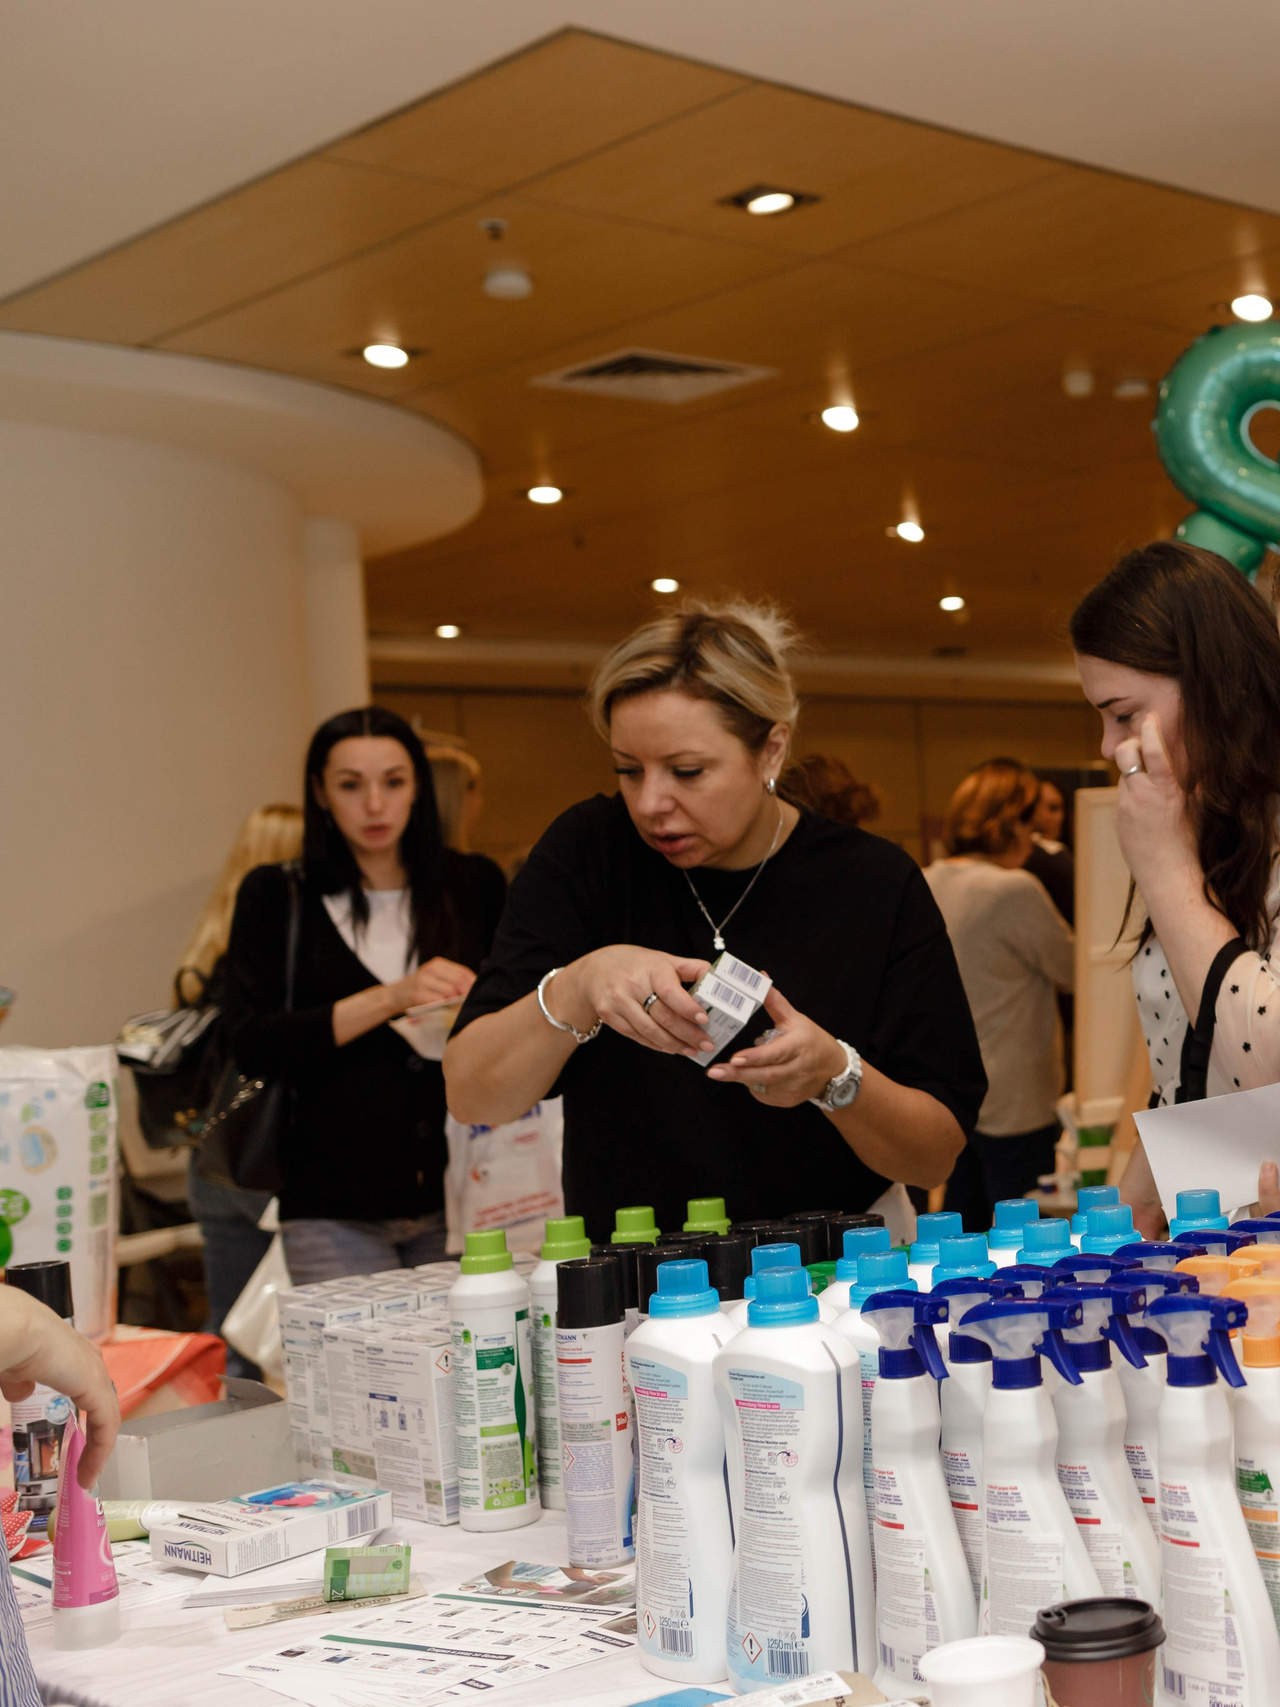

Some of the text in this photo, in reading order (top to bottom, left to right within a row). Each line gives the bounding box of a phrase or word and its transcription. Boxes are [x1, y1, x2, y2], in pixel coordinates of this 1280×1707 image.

[175, 1520, 231, 1536] HEITMANN
[164, 1544, 212, 1566] HEITMANN
[767, 1638, 784, 1650] 1250
